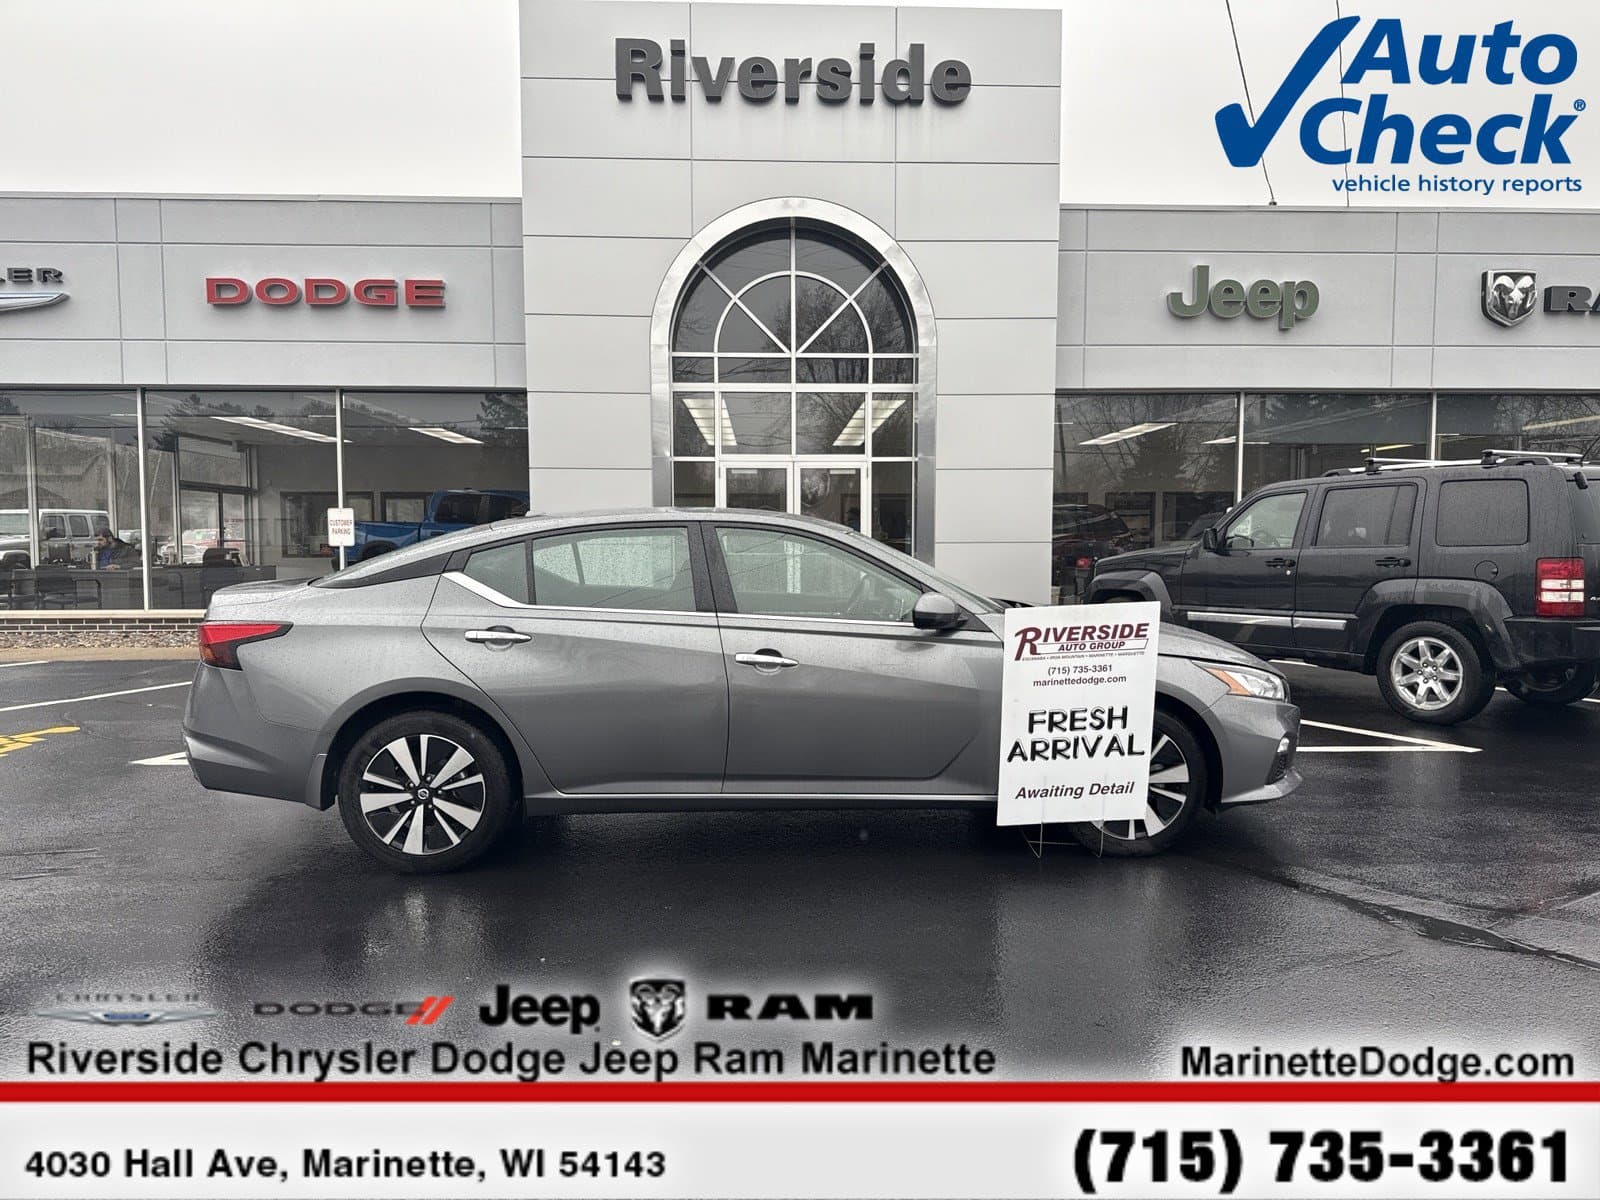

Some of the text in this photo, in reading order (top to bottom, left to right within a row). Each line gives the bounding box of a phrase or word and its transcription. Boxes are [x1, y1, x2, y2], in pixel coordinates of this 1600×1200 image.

[615, 37, 972, 106] Riverside
[0, 266, 64, 284] ER
[205, 276, 446, 309] DODGE
[1167, 265, 1320, 331] Jeep
[1543, 285, 1600, 313] R
[1014, 623, 1150, 661] RIVERSIDE
[1058, 641, 1126, 652] AUTO GROUP
[1033, 675, 1127, 688] marinettedodge.com
[1047, 664, 1113, 676] (715) 735-3361
[1028, 705, 1128, 734] FRESH
[1007, 733, 1145, 763] ARRIVAL
[1015, 782, 1135, 800] Awaiting Detail
